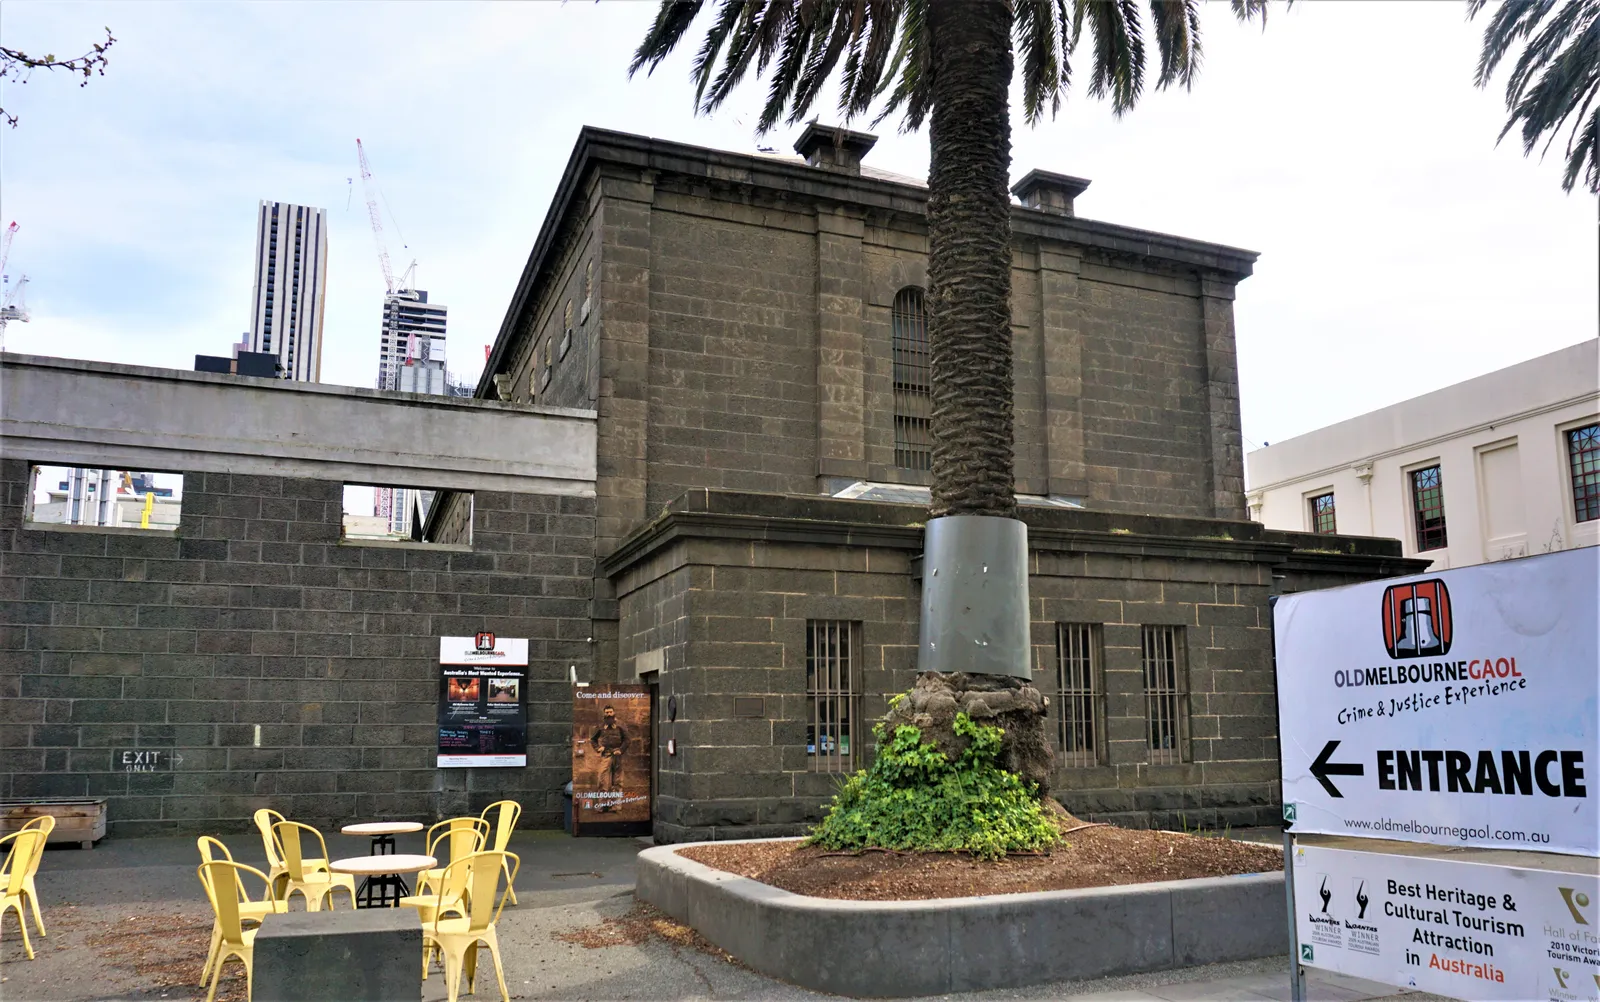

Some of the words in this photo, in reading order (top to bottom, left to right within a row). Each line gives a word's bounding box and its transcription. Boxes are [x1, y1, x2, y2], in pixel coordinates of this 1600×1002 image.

[576, 691, 597, 699] Come
[597, 691, 612, 699] and
[1337, 705, 1373, 725] Crime
[1376, 700, 1386, 717] &
[1388, 692, 1440, 718] Justice
[1444, 677, 1527, 705] Experience
[122, 751, 160, 764] EXIT
[125, 764, 155, 772] ONLY
[1376, 750, 1587, 798] ENTRANCE
[1344, 817, 1551, 844] www.oldmelbournegaol.com.au
[1387, 879, 1421, 899] Best
[1425, 884, 1497, 911] Heritage
[1502, 894, 1517, 912] &
[1384, 901, 1449, 925] Cultural
[1452, 910, 1525, 938] Tourism
[1314, 924, 1342, 935] WINNER
[1350, 930, 1380, 942] WINNER
[1543, 925, 1565, 938] Hall
[1569, 930, 1581, 941] of
[1584, 931, 1600, 944] Fa
[1412, 928, 1494, 957] Attraction
[1550, 941, 1571, 951] 2010
[1547, 950, 1581, 963] Tourism
[1405, 948, 1420, 966] in
[1429, 953, 1505, 983] Australia
[1548, 987, 1577, 1001] Winner
